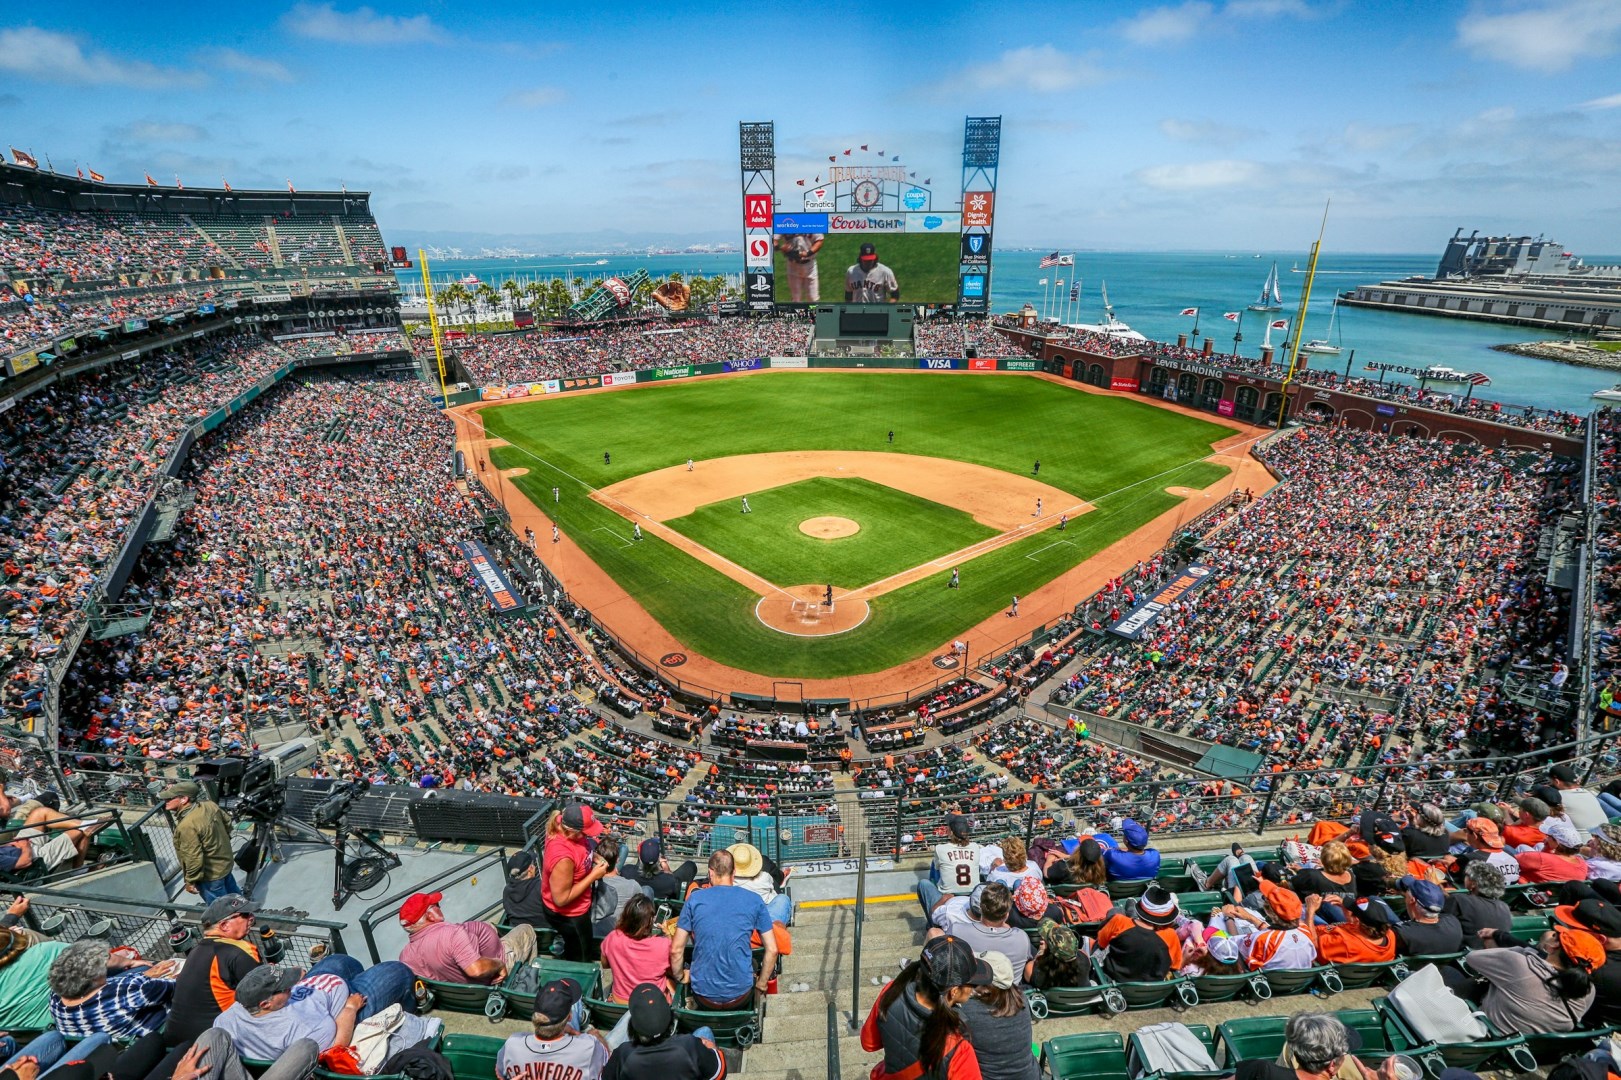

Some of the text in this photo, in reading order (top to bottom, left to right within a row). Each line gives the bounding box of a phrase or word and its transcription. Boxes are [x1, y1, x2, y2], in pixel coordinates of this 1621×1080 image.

[832, 216, 898, 230] Coors LIGHT
[437, 311, 514, 326] nuveen
[730, 359, 756, 368] YAHOO!
[927, 360, 951, 368] VISA
[664, 367, 689, 376] National
[1180, 363, 1223, 379] LANDING
[1368, 362, 1394, 371] BANK
[1411, 369, 1461, 381] AMERICA
[1115, 608, 1157, 634] WELCOME
[1144, 601, 1164, 611] TO
[1172, 576, 1197, 588] PARK
[947, 850, 974, 861] PENCE
[806, 862, 832, 872] 315
[956, 864, 971, 886] 8
[506, 1062, 583, 1080] CRAWFORD
